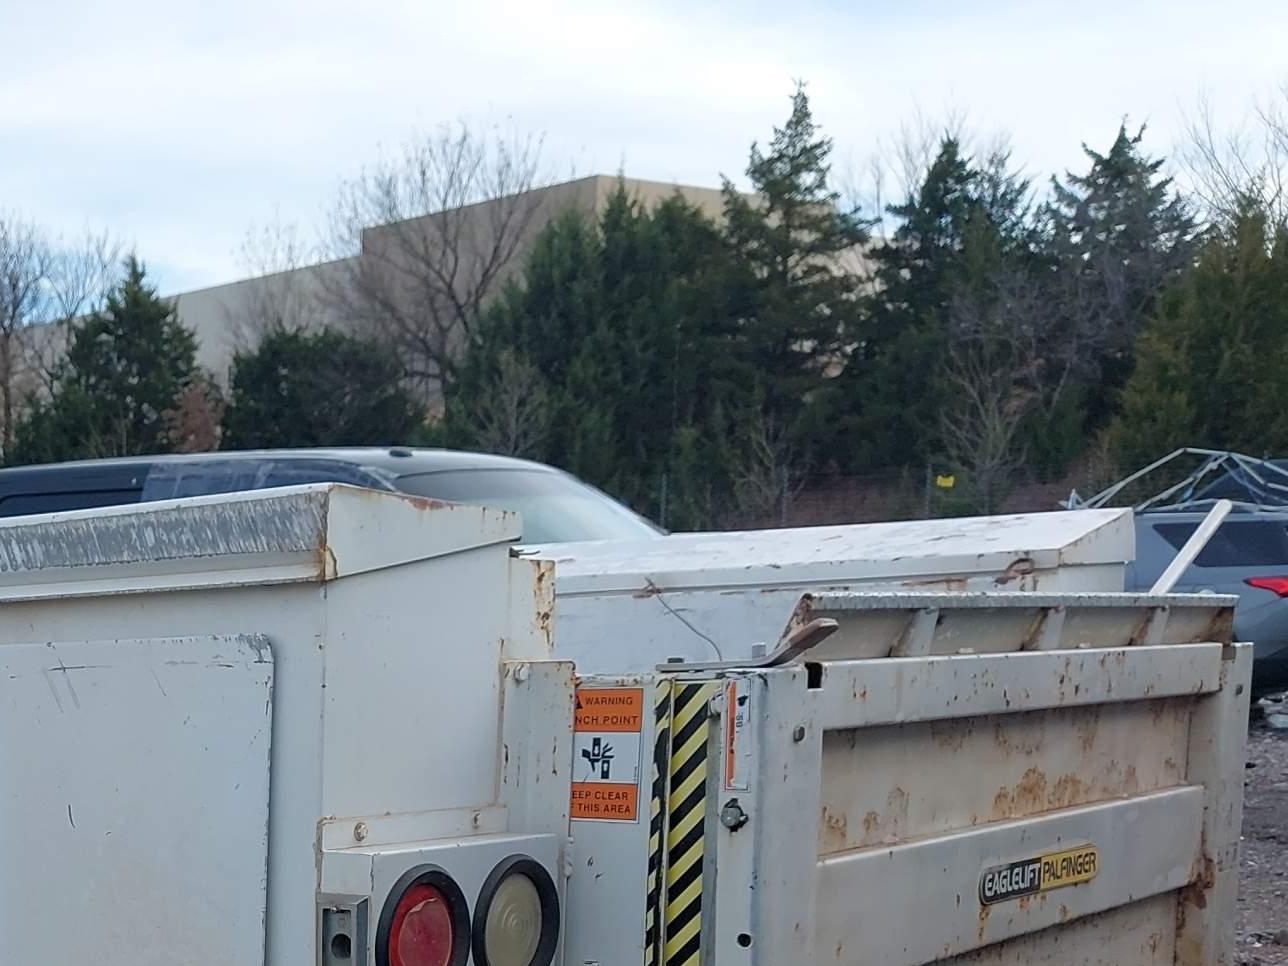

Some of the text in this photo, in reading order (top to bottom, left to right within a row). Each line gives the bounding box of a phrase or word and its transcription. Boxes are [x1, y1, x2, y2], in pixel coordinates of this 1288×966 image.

[585, 696, 633, 705] WARNING
[603, 715, 639, 725] POINT
[594, 791, 628, 800] CLEAR
[578, 803, 600, 812] THIS
[603, 804, 630, 813] AREA
[984, 851, 1097, 897] EAGLELIFT PALFINGER
